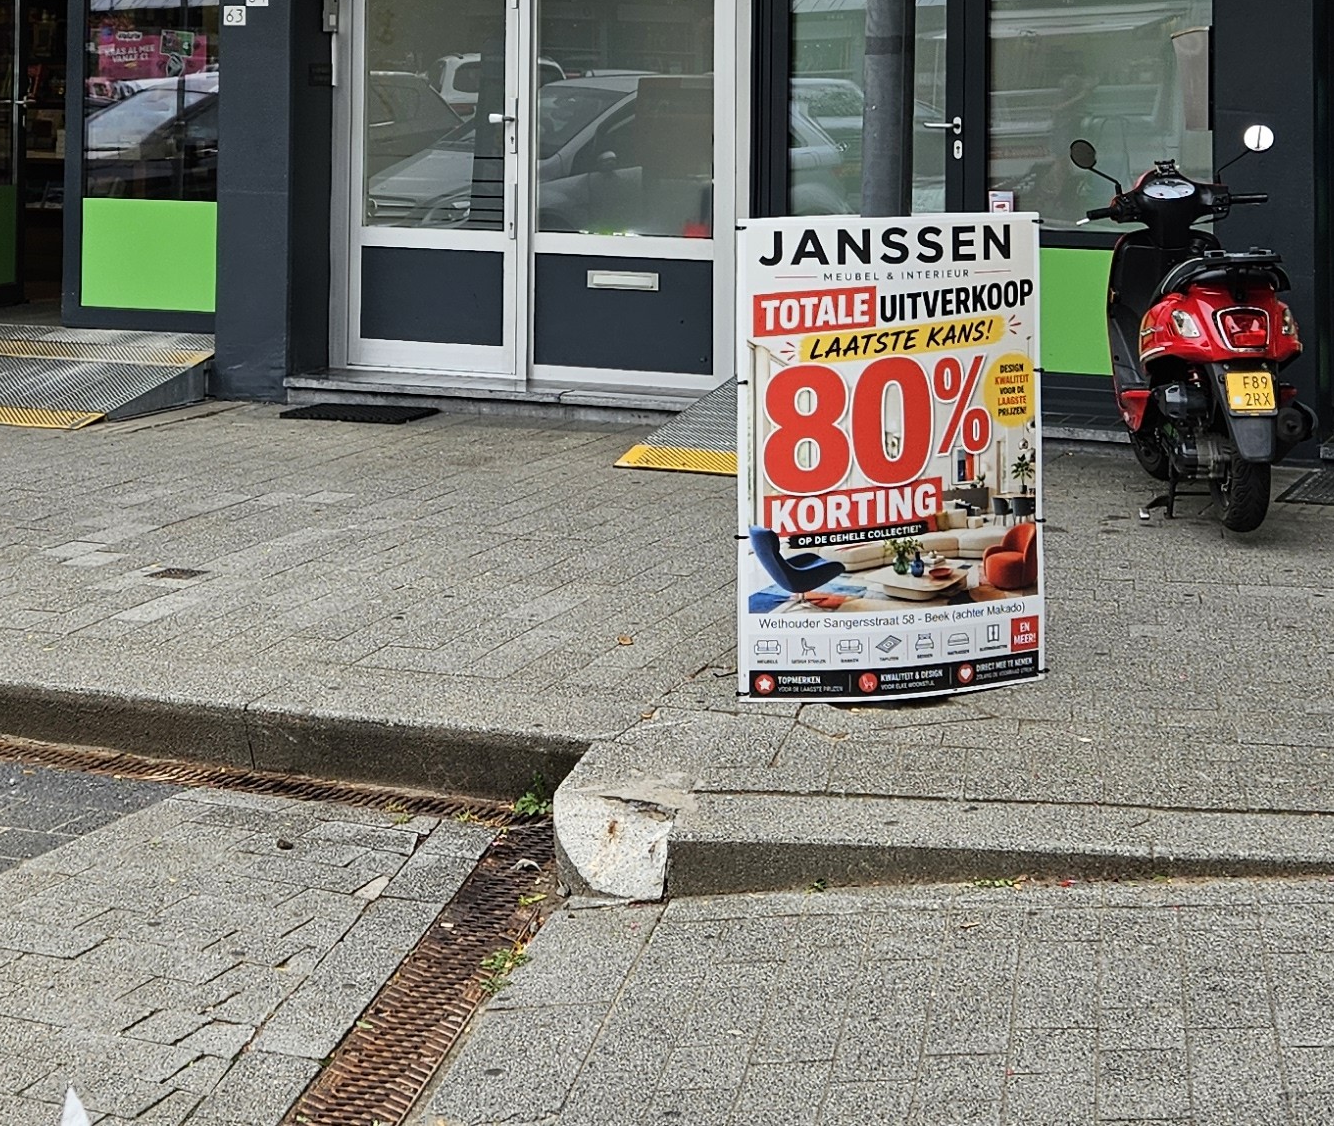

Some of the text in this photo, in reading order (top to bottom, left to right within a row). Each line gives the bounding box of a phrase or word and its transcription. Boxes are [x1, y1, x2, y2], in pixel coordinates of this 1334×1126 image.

[226, 8, 244, 23] 63
[758, 223, 1012, 267] JANSSEN
[823, 269, 969, 282] MEUBEL & INTERIEUR
[760, 278, 1034, 332] TOTALE UITVERKOOP
[809, 319, 994, 361] LAATSTE KANS!
[1000, 363, 1024, 374] DESIGN
[994, 373, 1030, 385] KWALITEIT
[1242, 376, 1268, 389] F89
[999, 385, 1025, 395] VOOR DE
[997, 395, 1027, 406] LAAGSTE
[1245, 392, 1271, 406] 2RX
[764, 355, 992, 496] 80%
[771, 483, 938, 534] KORTING
[798, 536, 813, 546] OP
[814, 535, 828, 545] DE
[829, 532, 866, 543] GEHELE
[902, 614, 915, 624] 58
[925, 612, 950, 623] Beek
[952, 608, 985, 623] (achter
[987, 602, 1026, 616] Makado)
[1019, 622, 1031, 632] EN
